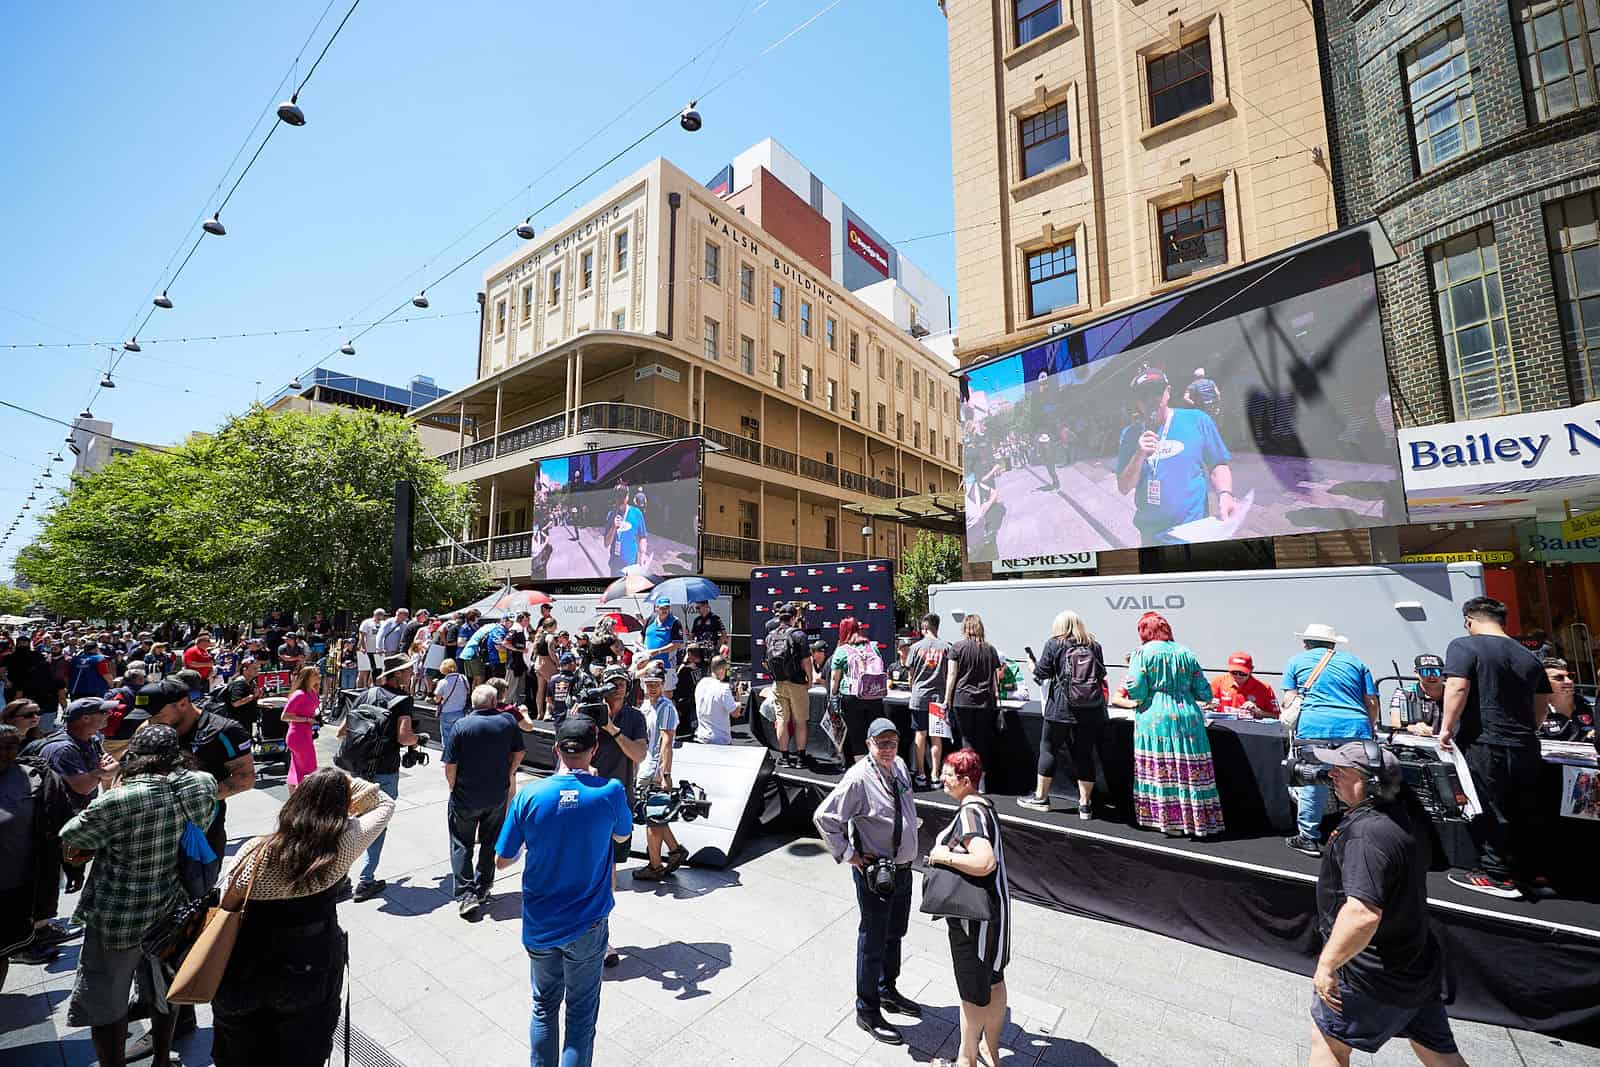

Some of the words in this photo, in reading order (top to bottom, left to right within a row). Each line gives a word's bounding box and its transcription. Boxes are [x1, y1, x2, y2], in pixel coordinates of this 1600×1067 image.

[554, 206, 620, 256] BUILDING
[708, 213, 758, 255] WALSH
[774, 258, 832, 305] BUILDING
[1408, 433, 1550, 471] Bailey
[564, 605, 586, 614] VAILO
[1105, 594, 1185, 610] VAILO
